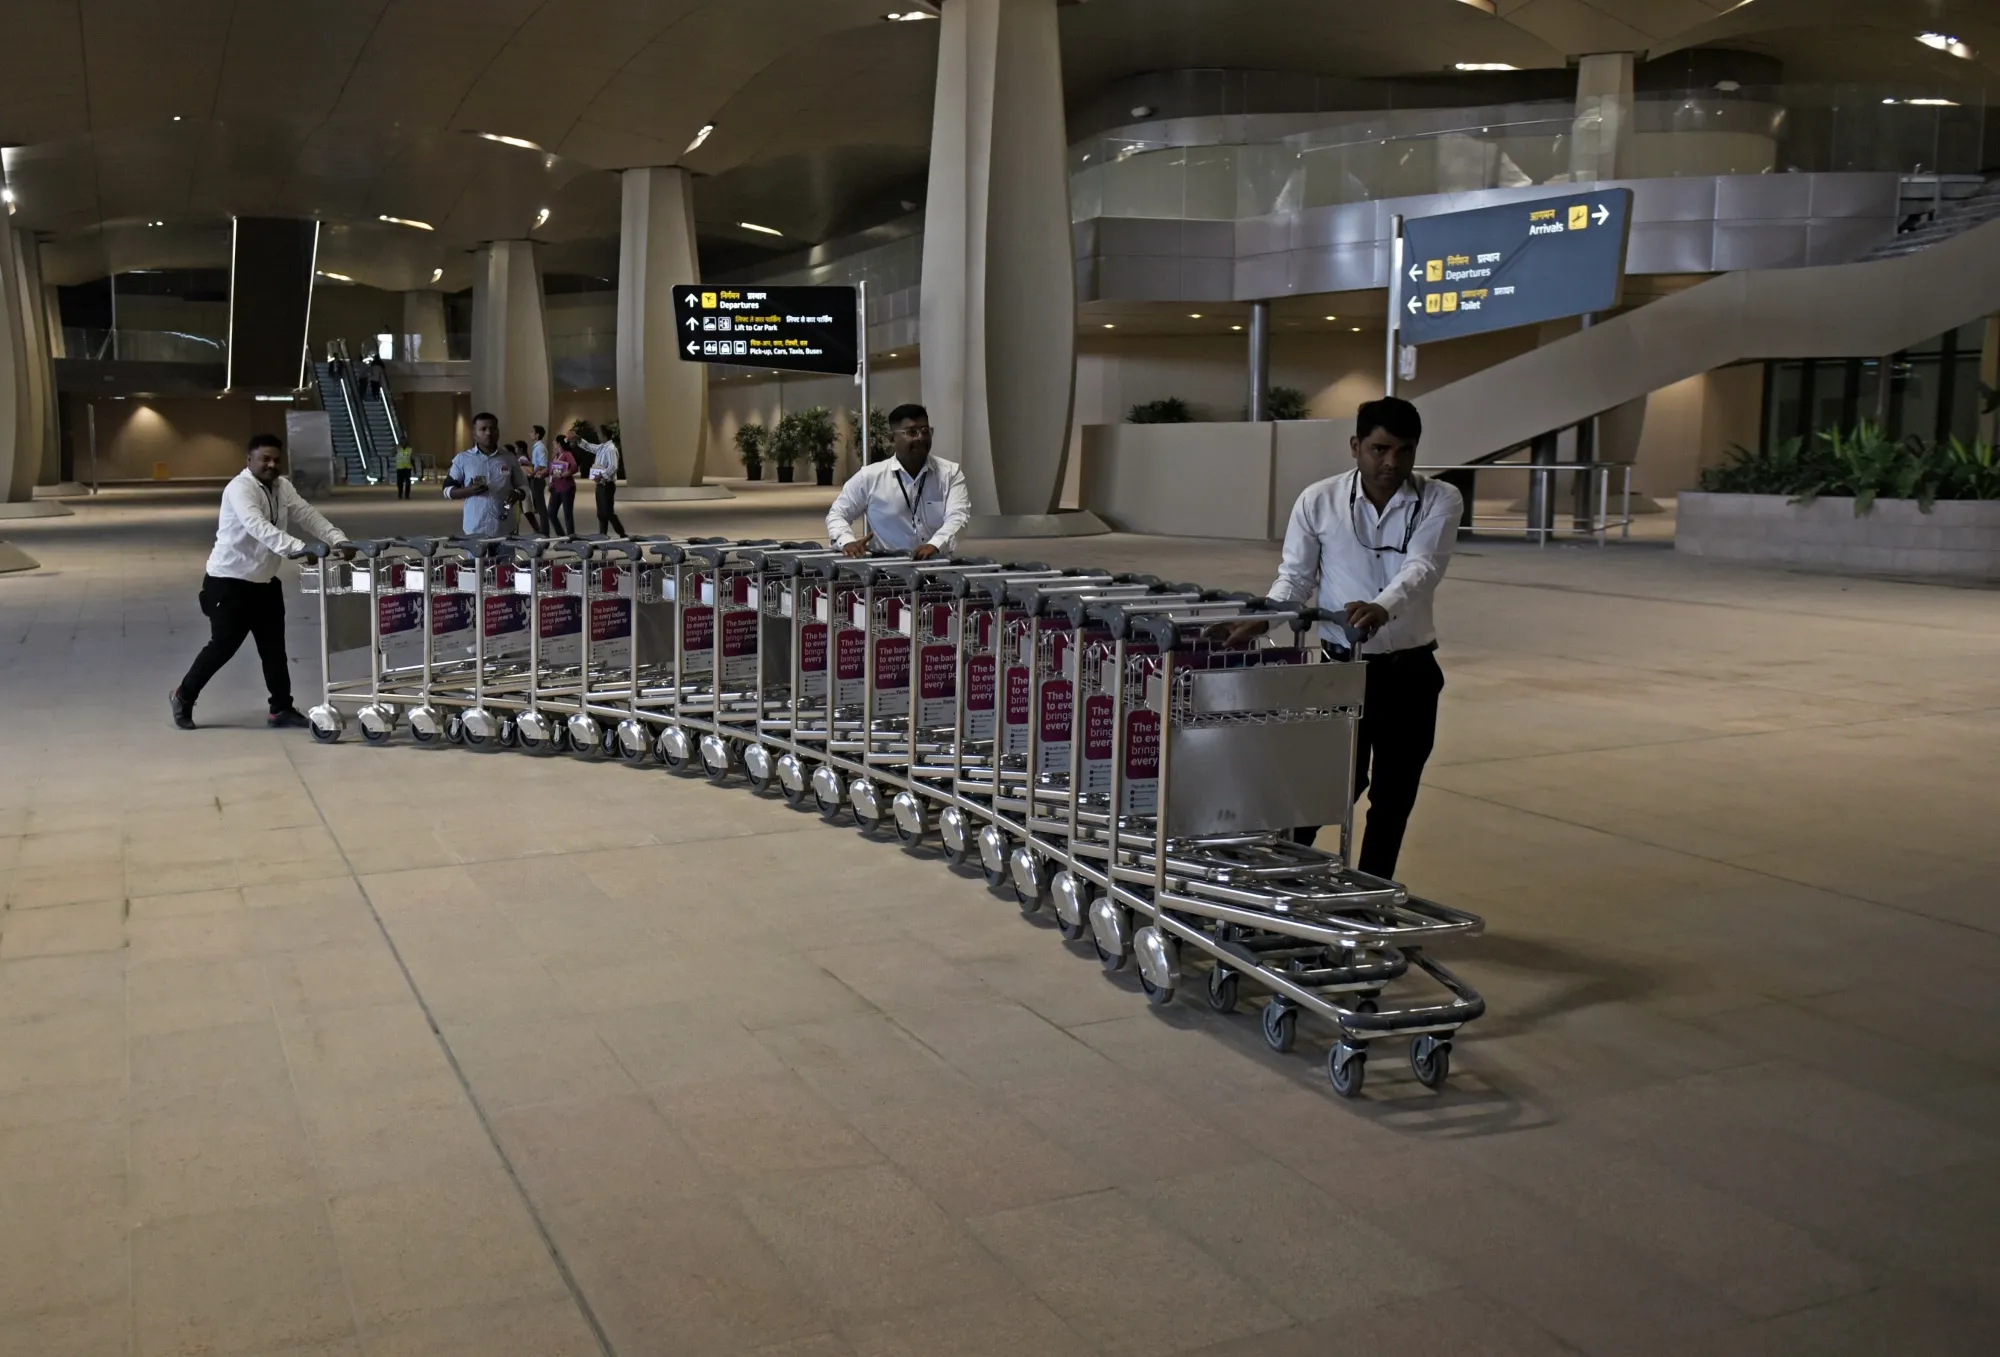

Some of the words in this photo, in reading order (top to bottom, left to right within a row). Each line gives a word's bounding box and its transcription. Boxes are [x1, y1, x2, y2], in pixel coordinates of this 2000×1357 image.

[1529, 221, 1564, 236] Arrivals
[1446, 268, 1491, 282] Departures
[720, 300, 760, 310] Departures
[1460, 300, 1481, 310] Toilet
[972, 665, 988, 673] The
[1012, 676, 1028, 685] The
[924, 682, 944, 690] every
[1012, 686, 1020, 695] to
[1046, 691, 1064, 700] The
[1046, 702, 1055, 710] to
[1092, 706, 1110, 716] The
[1091, 717, 1101, 726] to
[1045, 722, 1070, 731] every
[1133, 722, 1152, 732] The
[1090, 728, 1112, 738] bring
[1133, 735, 1142, 743] to
[1131, 757, 1158, 767] every
